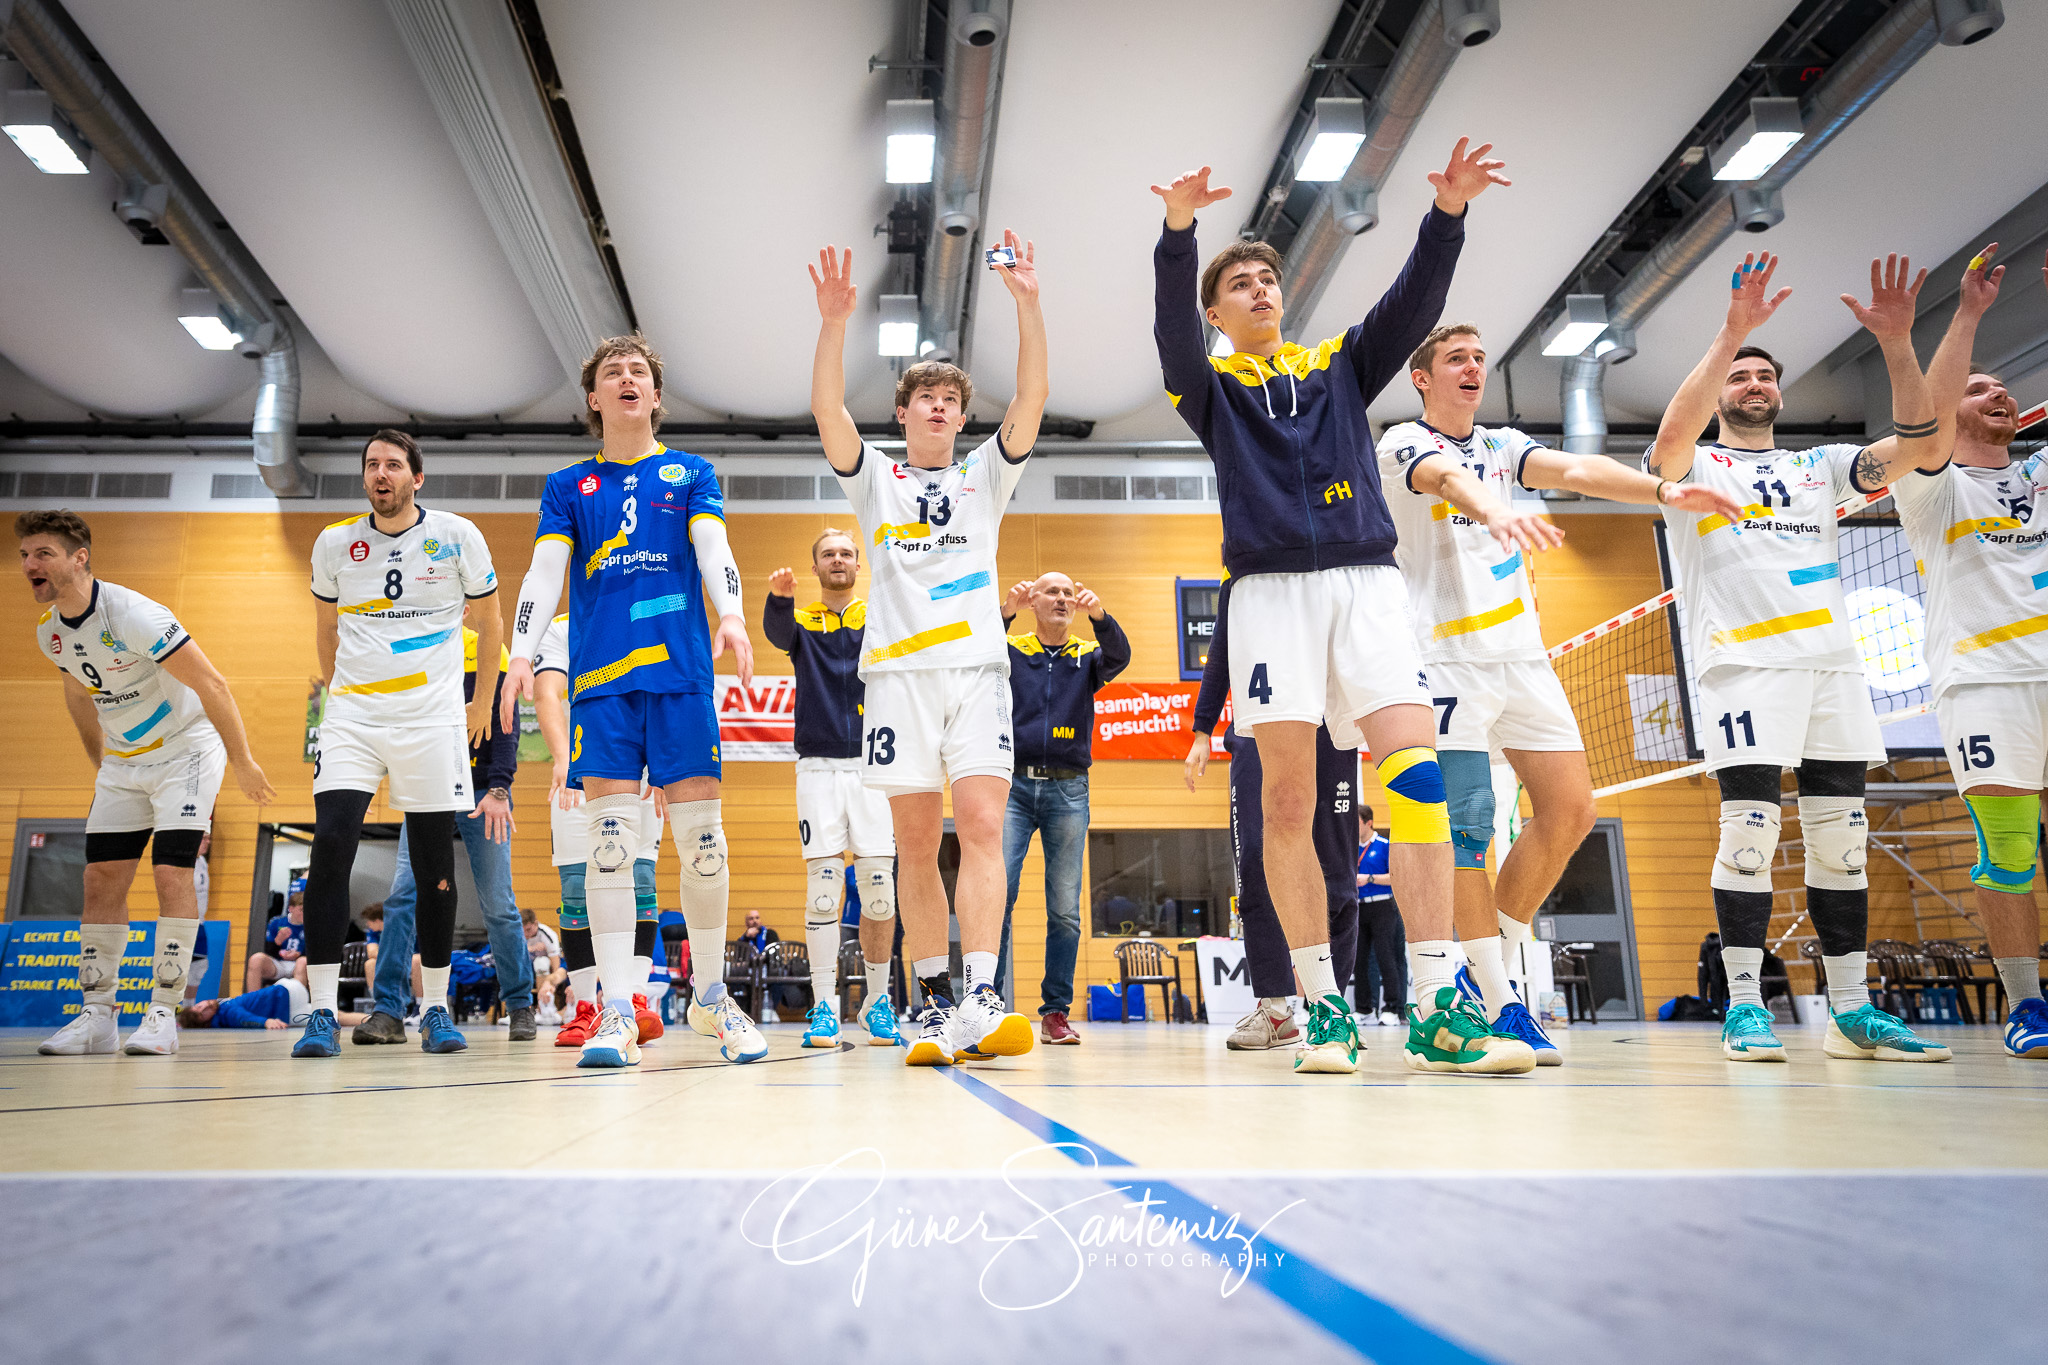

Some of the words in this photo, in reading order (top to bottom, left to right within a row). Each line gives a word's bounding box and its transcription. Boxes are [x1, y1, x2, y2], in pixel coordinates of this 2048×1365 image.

[1324, 480, 1353, 504] FH
[1752, 480, 1791, 507] 11
[620, 495, 638, 535] 3
[916, 495, 952, 526] 13
[1451, 515, 1477, 526] Zap
[923, 533, 967, 552] Dgfuss
[384, 568, 403, 600] 8
[81, 661, 103, 689] 9
[1247, 663, 1273, 705] 4
[1094, 692, 1191, 715] eamplayer
[1052, 726, 1075, 739] MM
[1099, 713, 1181, 741] gesucht!
[1717, 709, 1757, 750] 11
[570, 723, 584, 763] 3
[866, 726, 896, 767] 13
[1957, 734, 1996, 772] 15
[1333, 799, 1350, 814] SB
[601, 828, 620, 837] errea
[1746, 819, 1765, 829] errea
[1849, 820, 1866, 828] errea
[698, 840, 717, 851] errea
